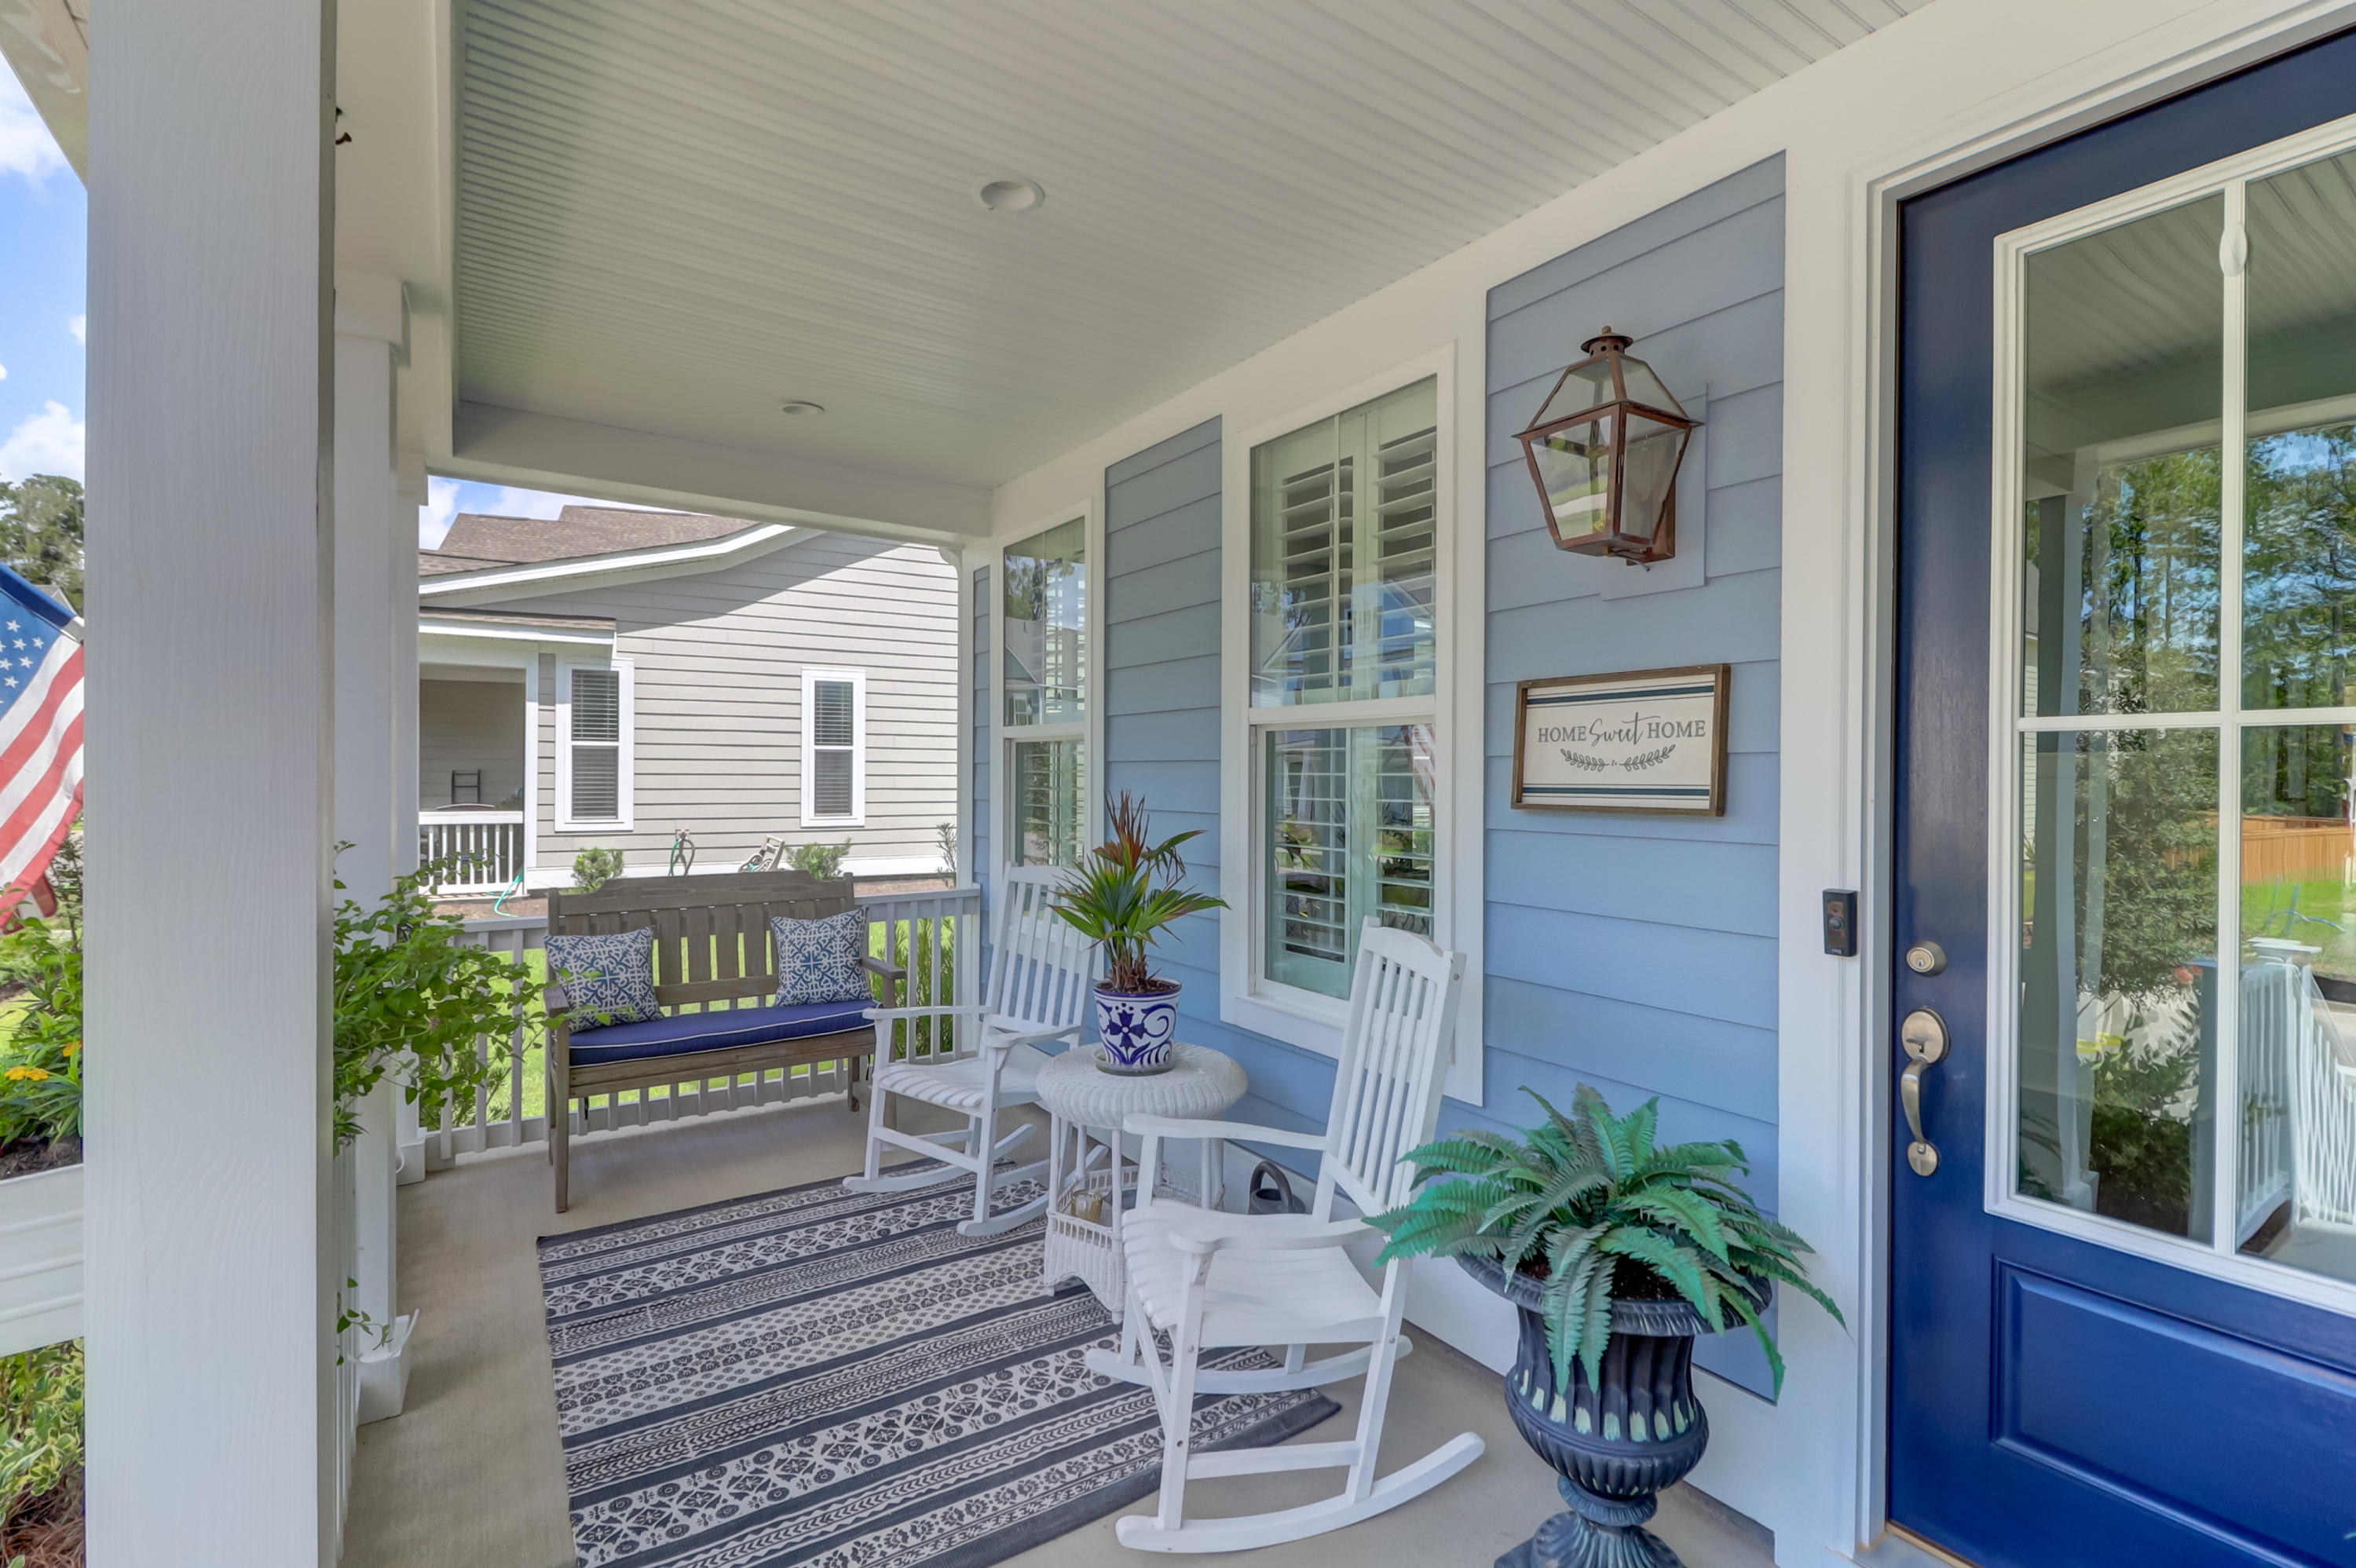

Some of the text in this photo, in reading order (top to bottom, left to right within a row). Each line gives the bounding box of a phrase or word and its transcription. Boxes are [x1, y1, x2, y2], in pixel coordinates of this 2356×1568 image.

[1538, 711, 1707, 747] HOME Sweet HOME
